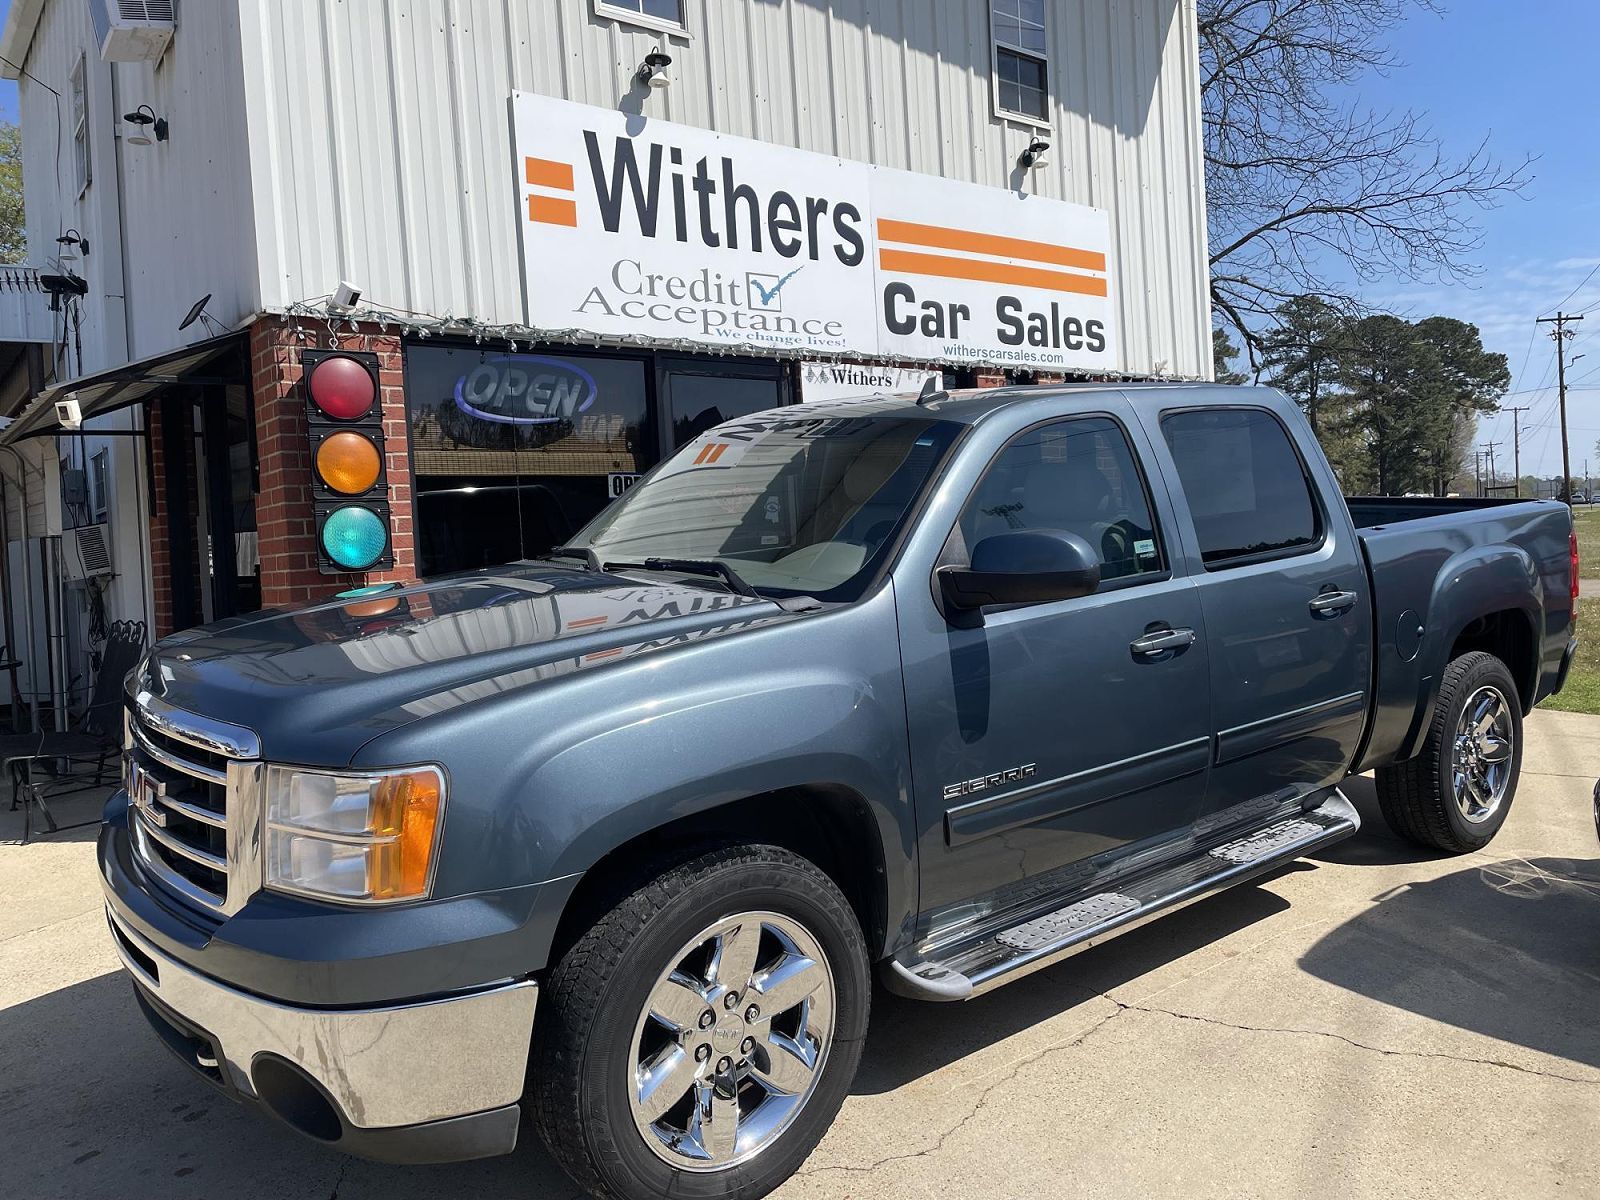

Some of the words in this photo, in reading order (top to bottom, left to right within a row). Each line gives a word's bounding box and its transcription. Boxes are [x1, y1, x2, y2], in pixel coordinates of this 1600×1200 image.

[582, 129, 865, 267] Withers
[611, 259, 743, 307] Credit
[572, 286, 844, 335] Acceptance
[883, 281, 971, 340] Car
[996, 295, 1106, 352] Sales
[716, 328, 741, 339] We
[746, 331, 803, 346] change
[807, 336, 846, 348] lives!
[943, 344, 1064, 363] witherscarsales.com
[464, 364, 583, 417] OPEN
[831, 369, 893, 387] Withers
[943, 762, 1037, 800] SIERRA
